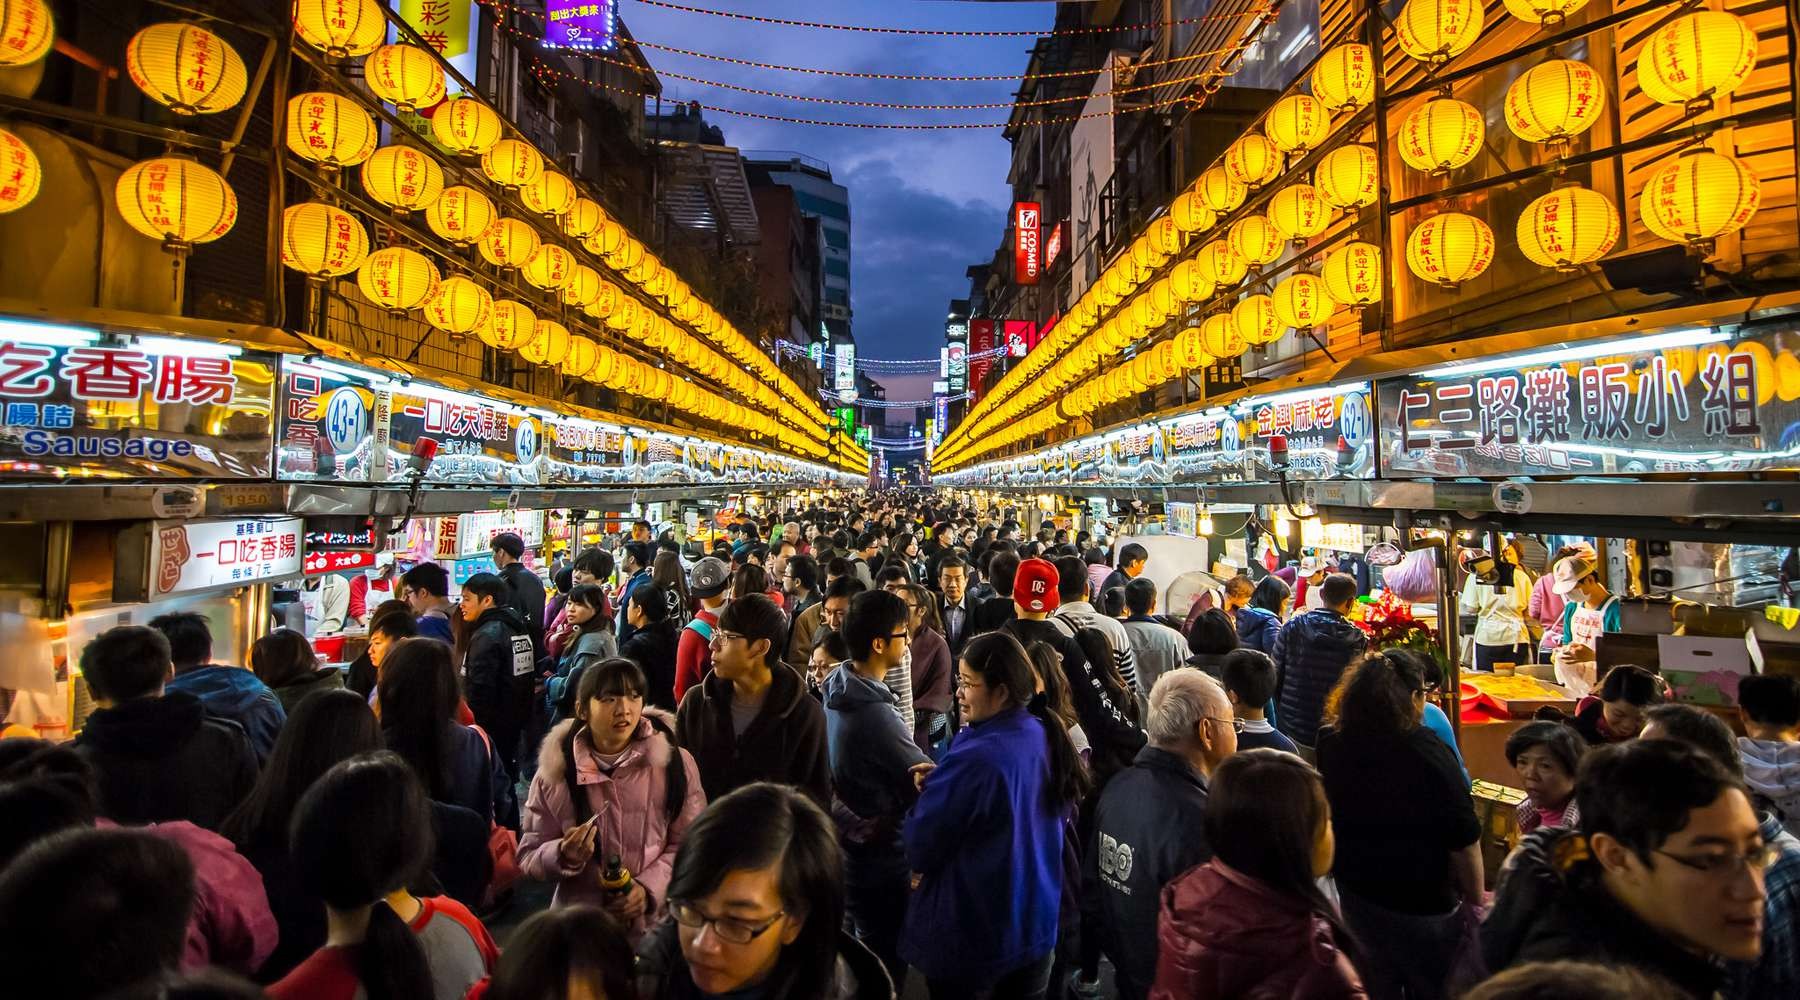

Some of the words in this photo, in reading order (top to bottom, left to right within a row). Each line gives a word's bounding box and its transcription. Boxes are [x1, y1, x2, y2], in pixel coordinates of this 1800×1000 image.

[1027, 231, 1036, 277] COSMED
[1395, 354, 1762, 455] 仁三路攤販小組
[331, 400, 361, 443] 43-1
[1344, 402, 1365, 440] 62-1
[24, 431, 193, 460] Sausage
[520, 428, 532, 455] 43
[1225, 427, 1236, 451] 62
[1290, 455, 1321, 468] snacks
[196, 533, 296, 564] 一口吃香腸
